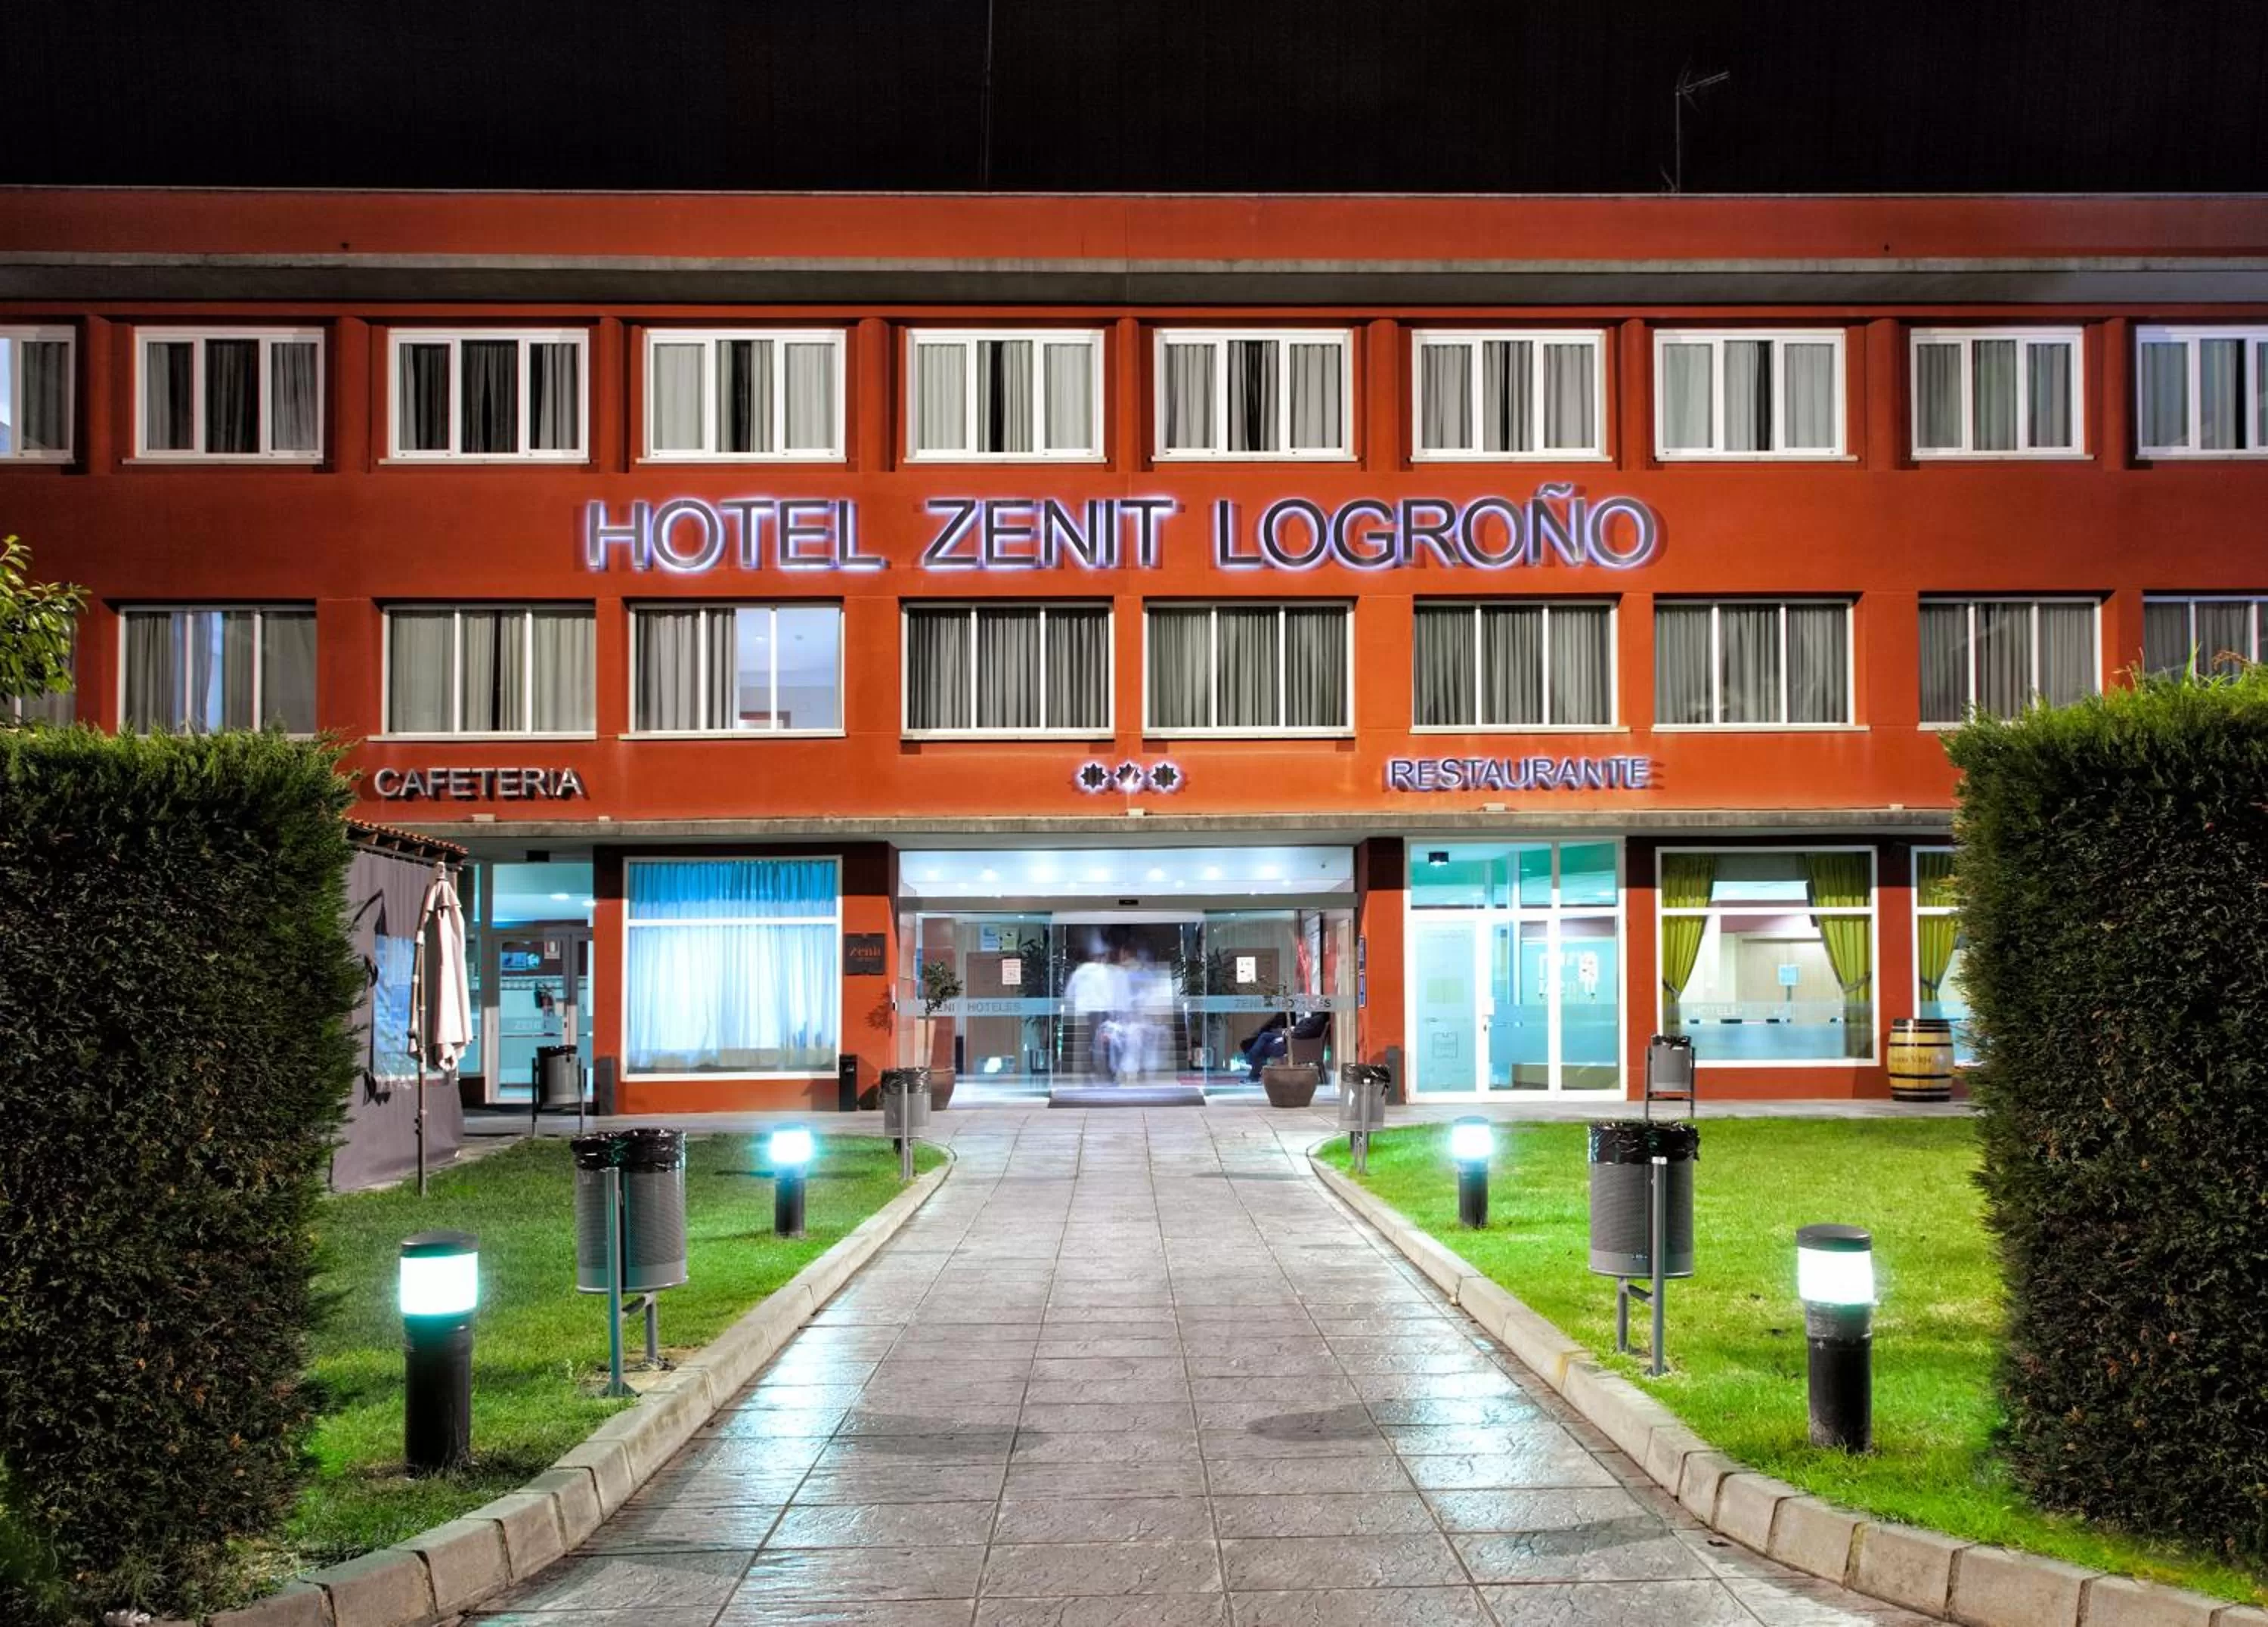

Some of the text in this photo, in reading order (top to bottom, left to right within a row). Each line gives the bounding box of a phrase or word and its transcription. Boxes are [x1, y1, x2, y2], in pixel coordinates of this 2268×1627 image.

[587, 482, 1657, 570] HOTEL ZENIT LOGROÑO
[373, 767, 583, 798] CAFETERIA
[1387, 757, 1652, 790] RESTAURANTE
